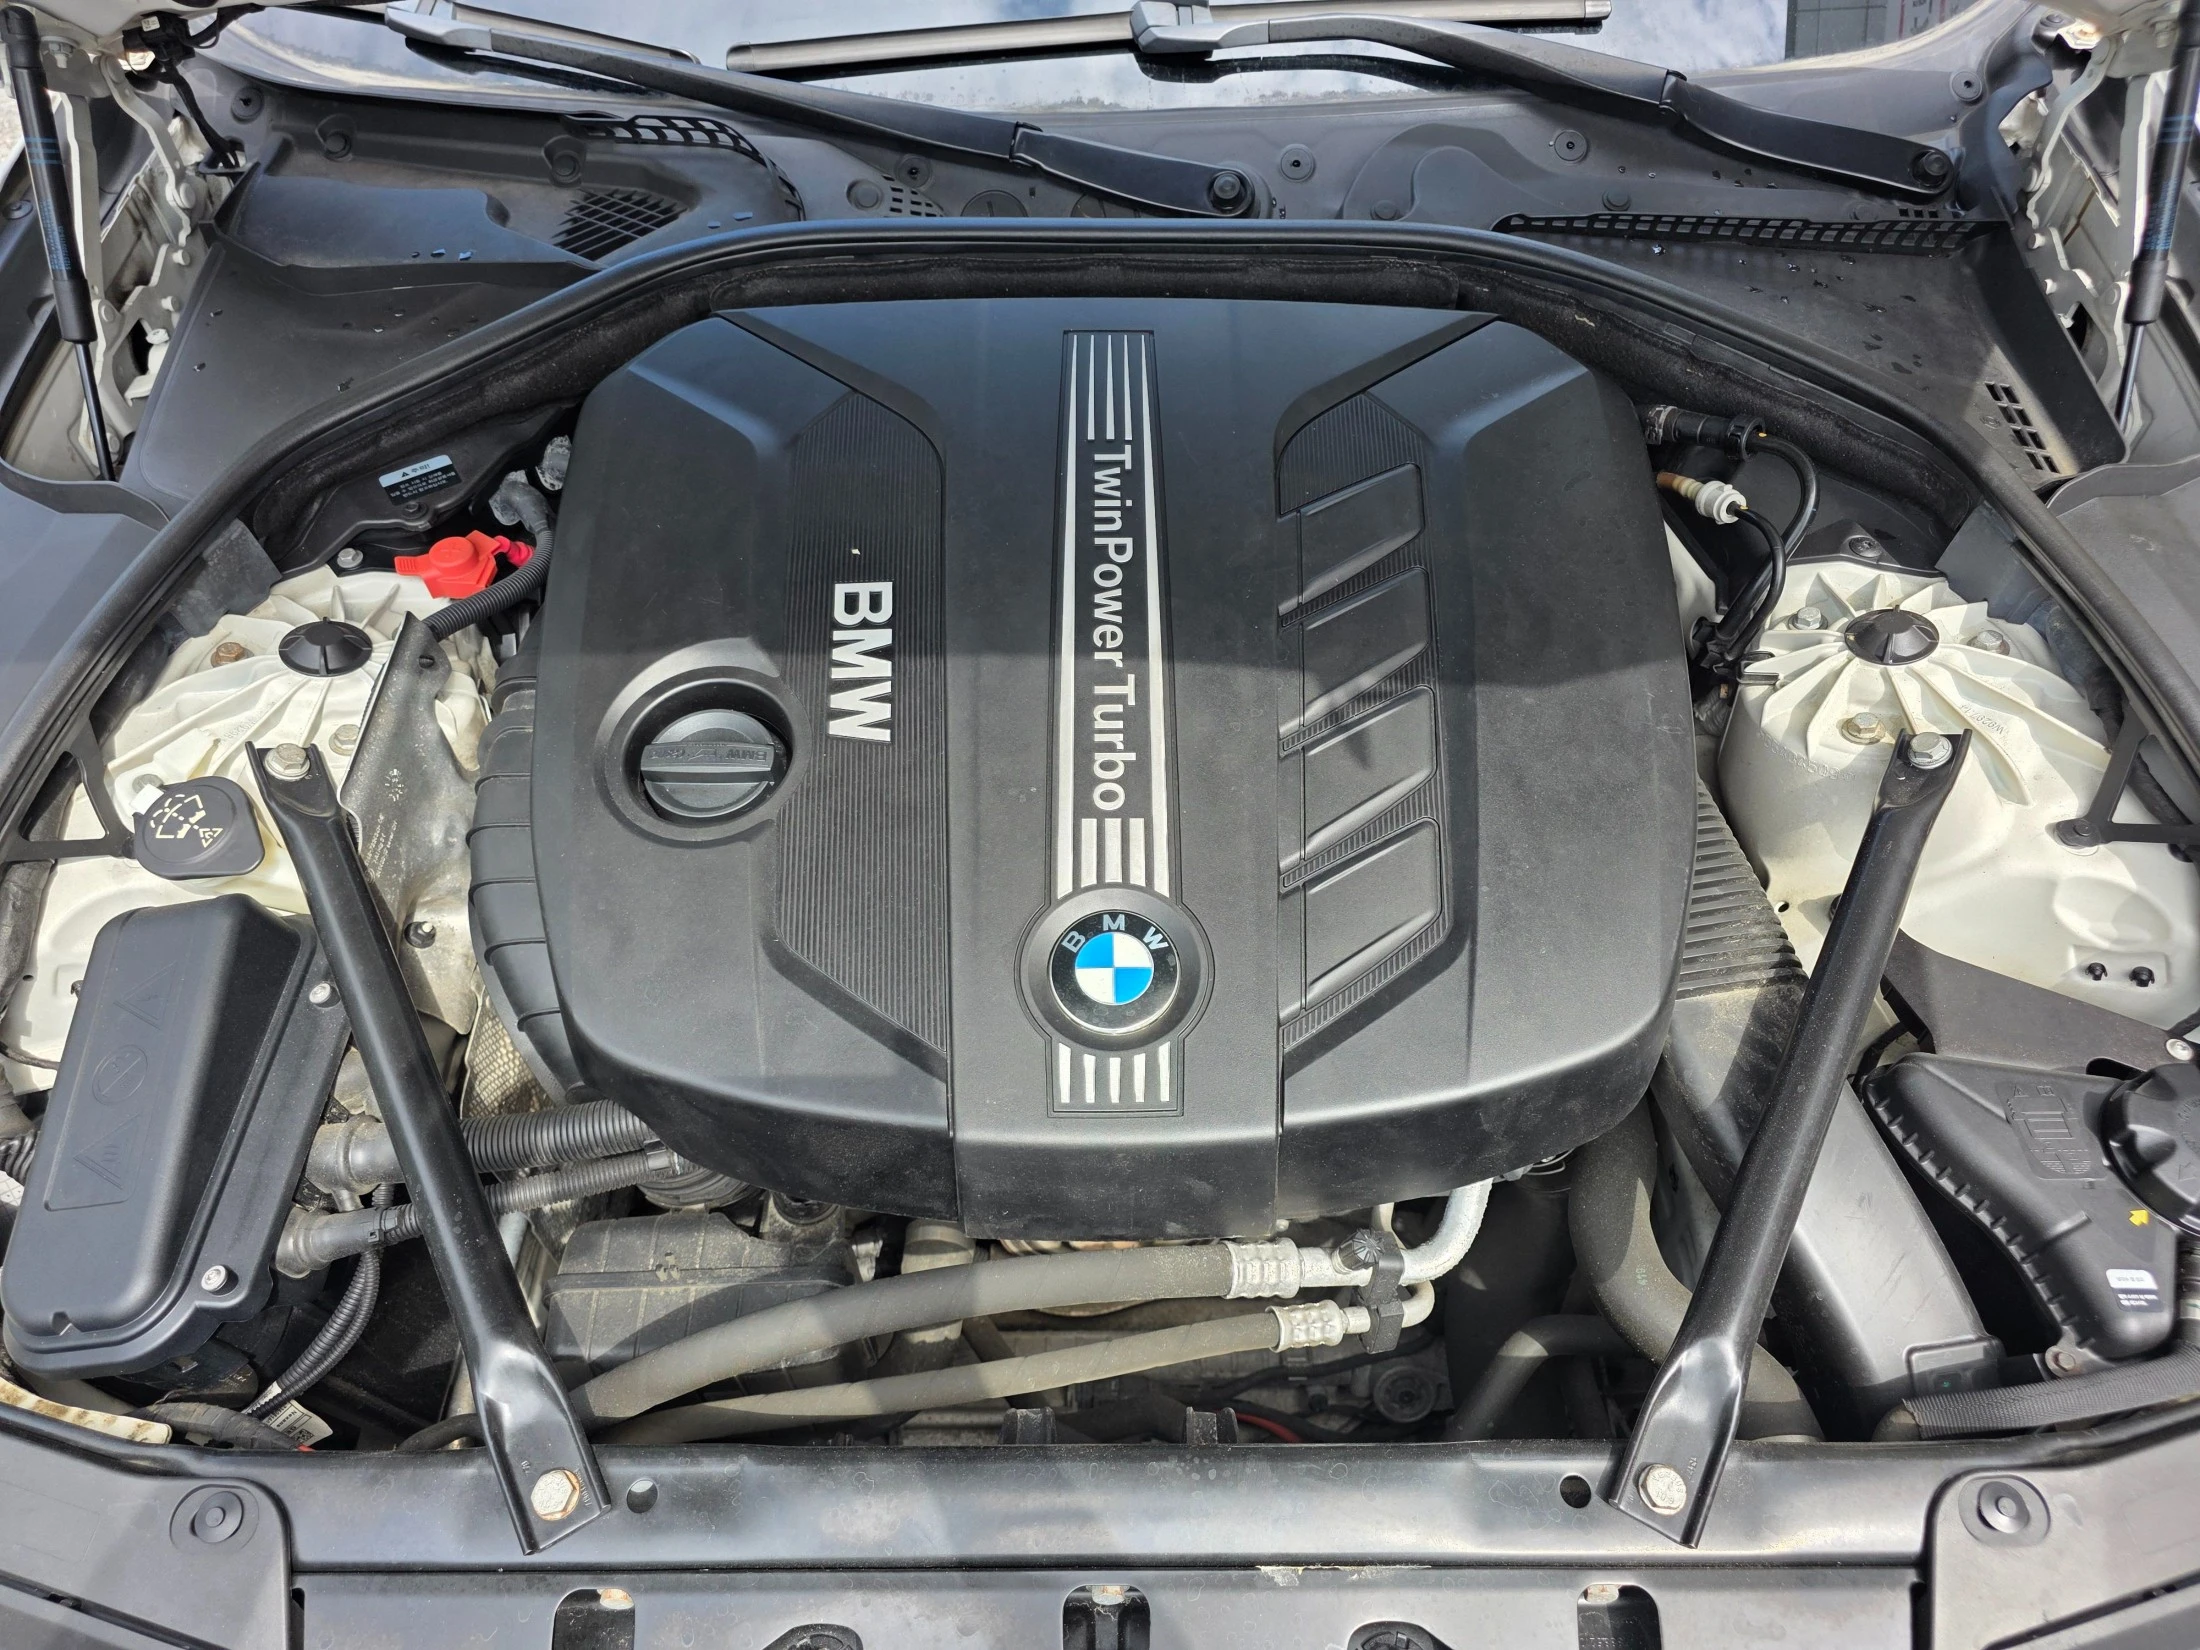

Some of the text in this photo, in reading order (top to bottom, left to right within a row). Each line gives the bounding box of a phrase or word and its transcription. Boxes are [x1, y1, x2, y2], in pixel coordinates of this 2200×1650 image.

[828, 580, 894, 742] BMW
[1092, 443, 1137, 812] TwinPower Turbo
[726, 747, 768, 762] BMW
[1061, 913, 1169, 954] BMW
